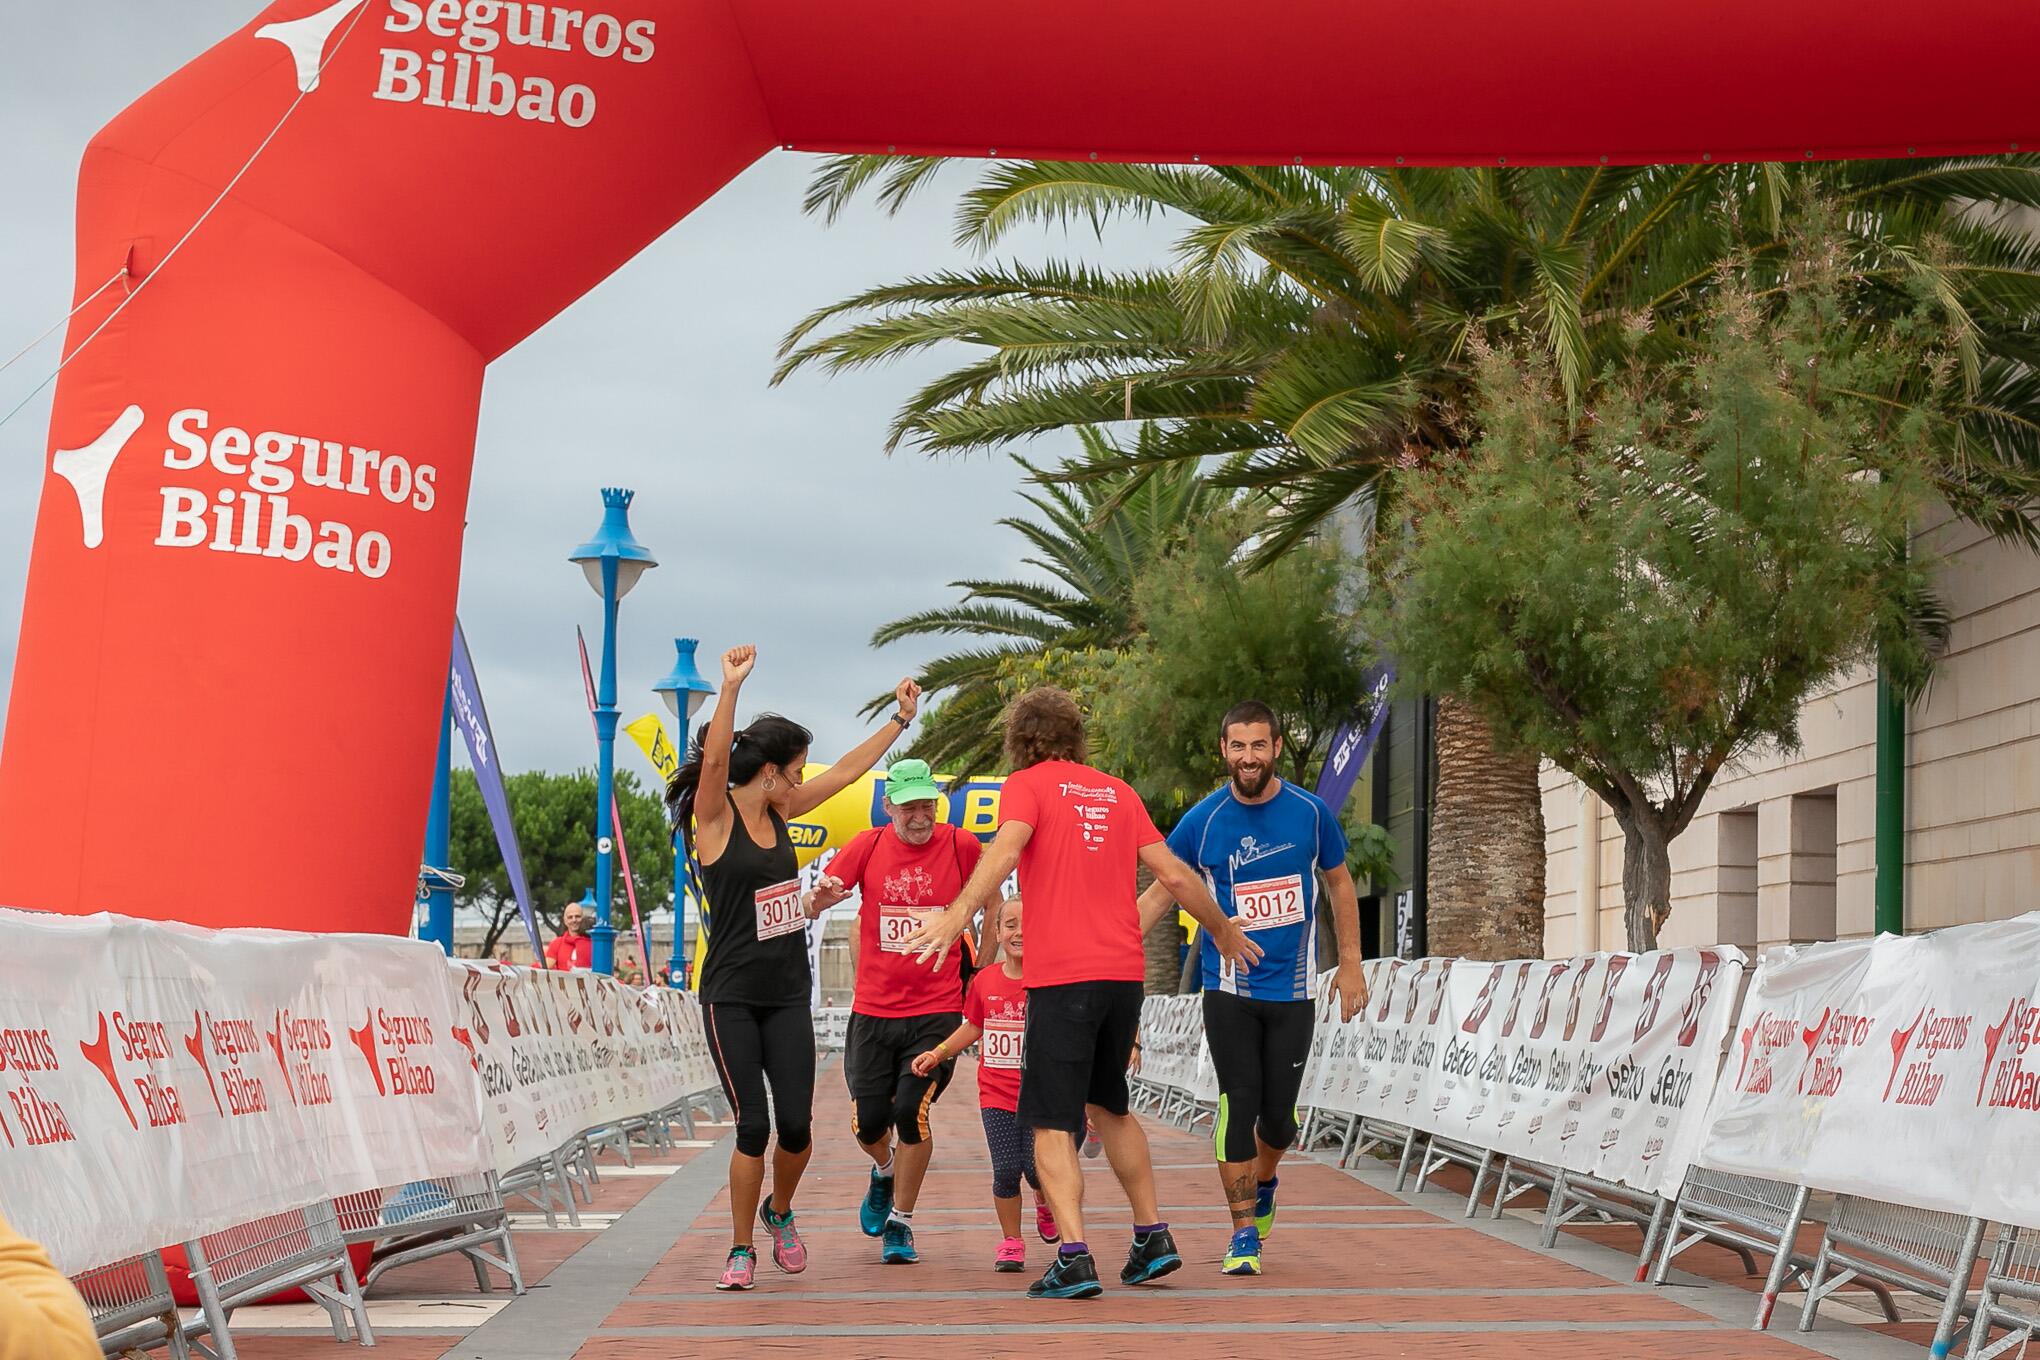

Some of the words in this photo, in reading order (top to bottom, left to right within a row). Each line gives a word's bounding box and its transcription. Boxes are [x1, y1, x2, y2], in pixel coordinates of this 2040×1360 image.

[384, 0, 656, 63] Seguros
[372, 47, 597, 128] Bilbao
[163, 408, 437, 512] Seguros
[154, 486, 392, 579] Bilbao
[787, 826, 823, 845] BM
[762, 893, 801, 927] 3012
[1244, 890, 1298, 919] 3012
[377, 1007, 434, 1054] Seguros
[988, 1032, 1022, 1057] 301
[1915, 1007, 1973, 1060] Seguros
[1442, 1035, 1478, 1078] Getxo
[1508, 1044, 1542, 1089] Getxo
[1650, 1054, 1694, 1110] Getxo
[1895, 1062, 1944, 1107] Bilbao
